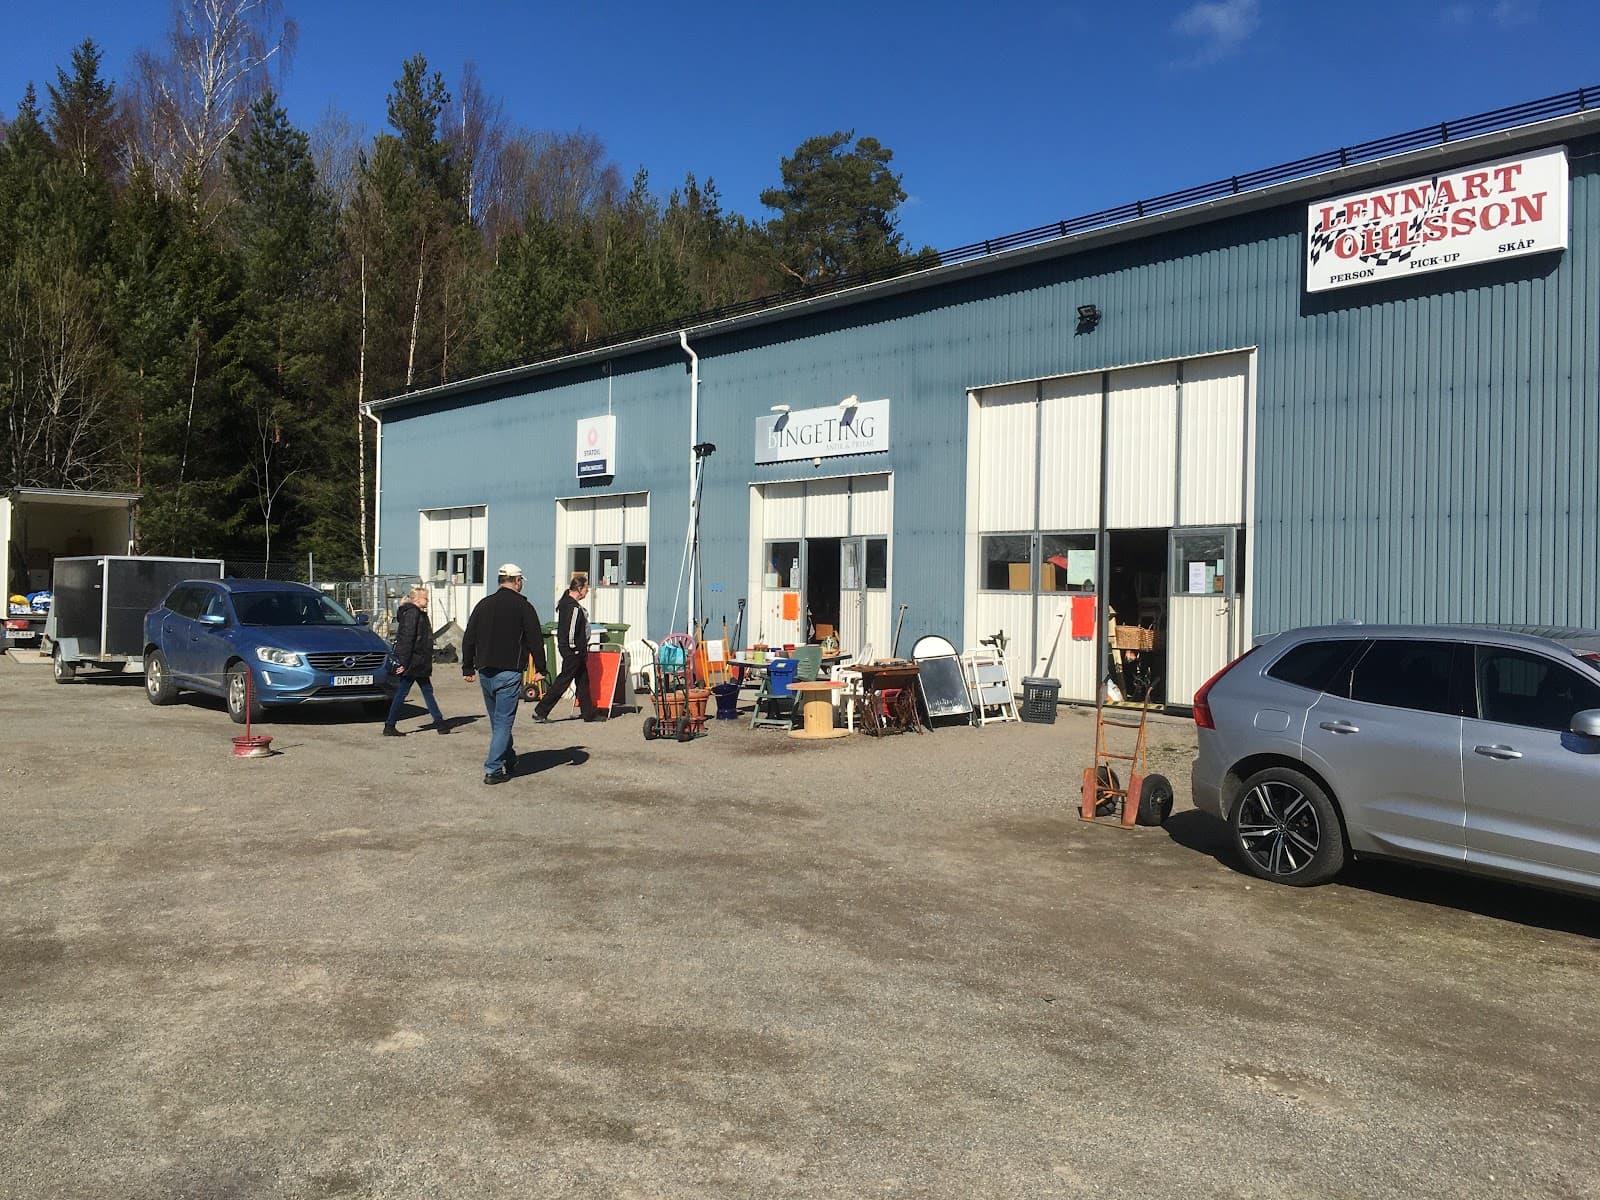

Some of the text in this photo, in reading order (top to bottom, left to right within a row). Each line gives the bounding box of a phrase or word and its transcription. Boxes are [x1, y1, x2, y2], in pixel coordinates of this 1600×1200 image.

[1319, 164, 1522, 232] LENNART
[1334, 192, 1547, 259] OHLSSON
[1329, 239, 1535, 283] PERSON PICK-UP SKÅP
[768, 417, 874, 449] BINGETING
[337, 676, 353, 685] DNM
